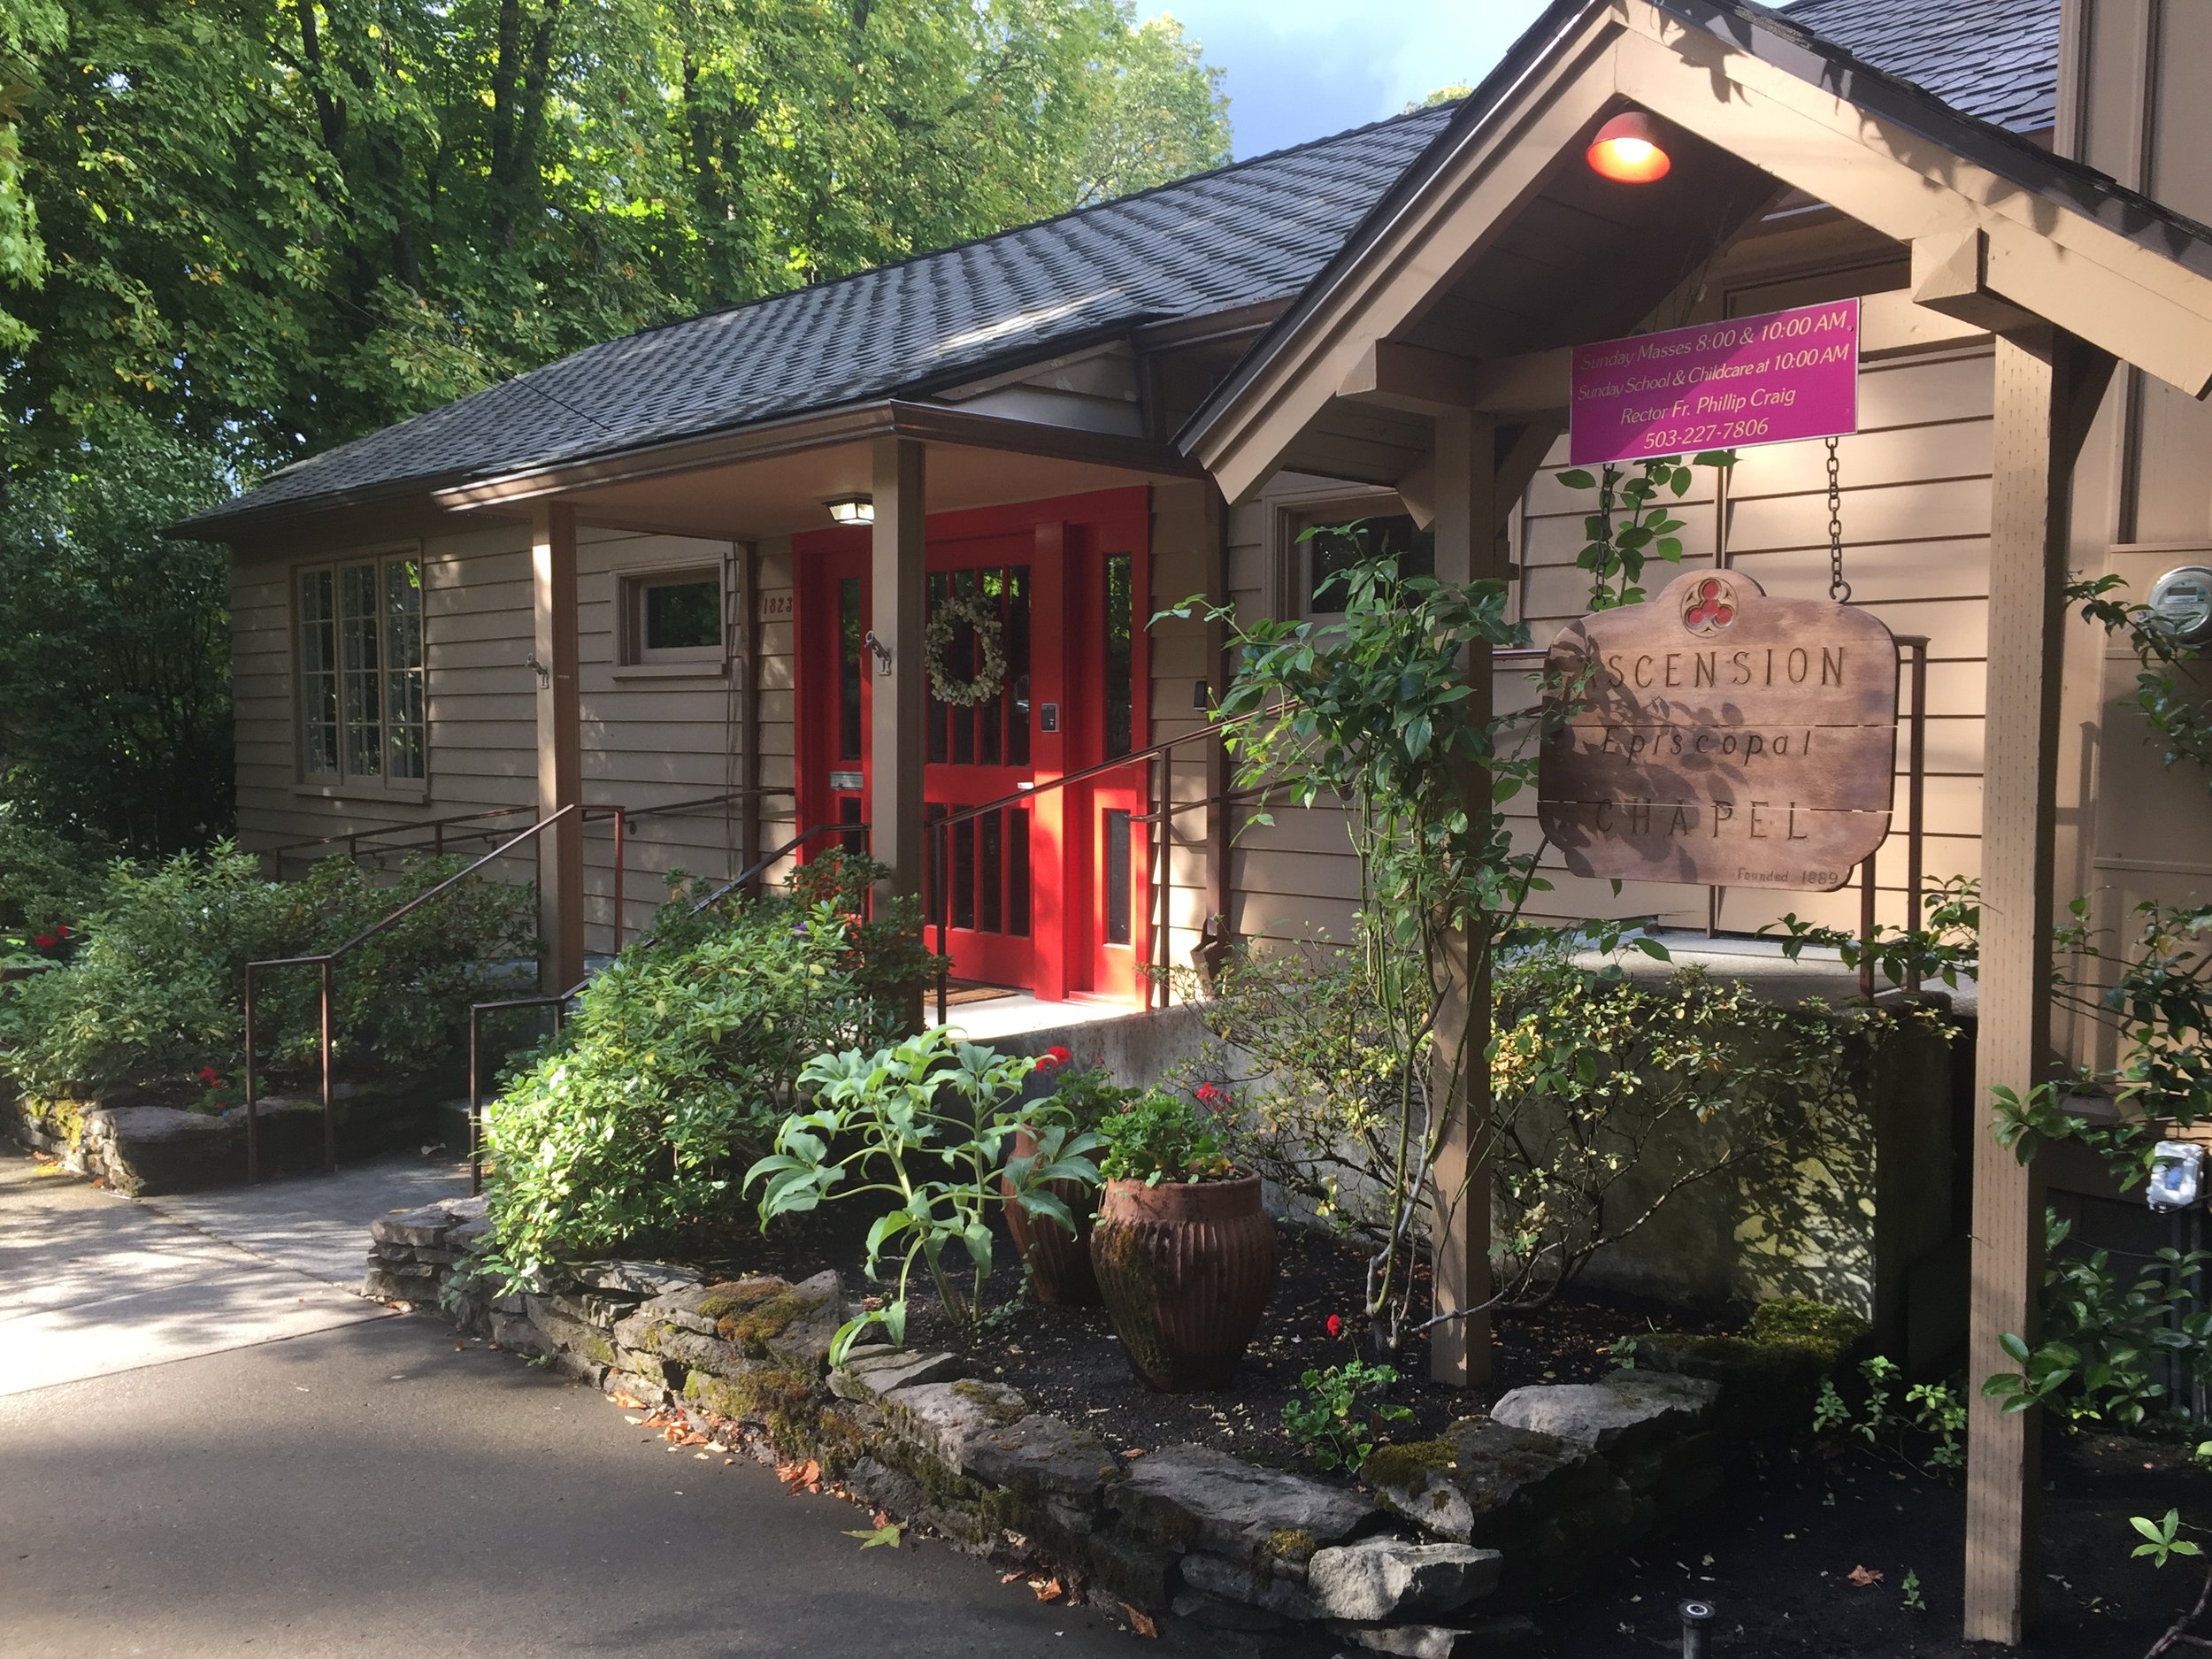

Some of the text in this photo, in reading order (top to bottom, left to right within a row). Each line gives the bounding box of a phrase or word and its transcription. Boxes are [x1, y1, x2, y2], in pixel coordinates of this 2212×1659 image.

[1580, 311, 1847, 370] Sunday Masses 8:00 & 10:00 AM
[1578, 343, 1849, 401] Sunday School & Childcare at 10:00 AM
[1621, 388, 1795, 425] Rector Fr. Phillip Craig
[1644, 417, 1769, 449] 503-227-7806
[764, 596, 793, 614] 1823
[1602, 726, 1810, 766] Episcopal
[1596, 797, 1809, 840] CHAPEL
[1737, 867, 1839, 885] Founded 1889
